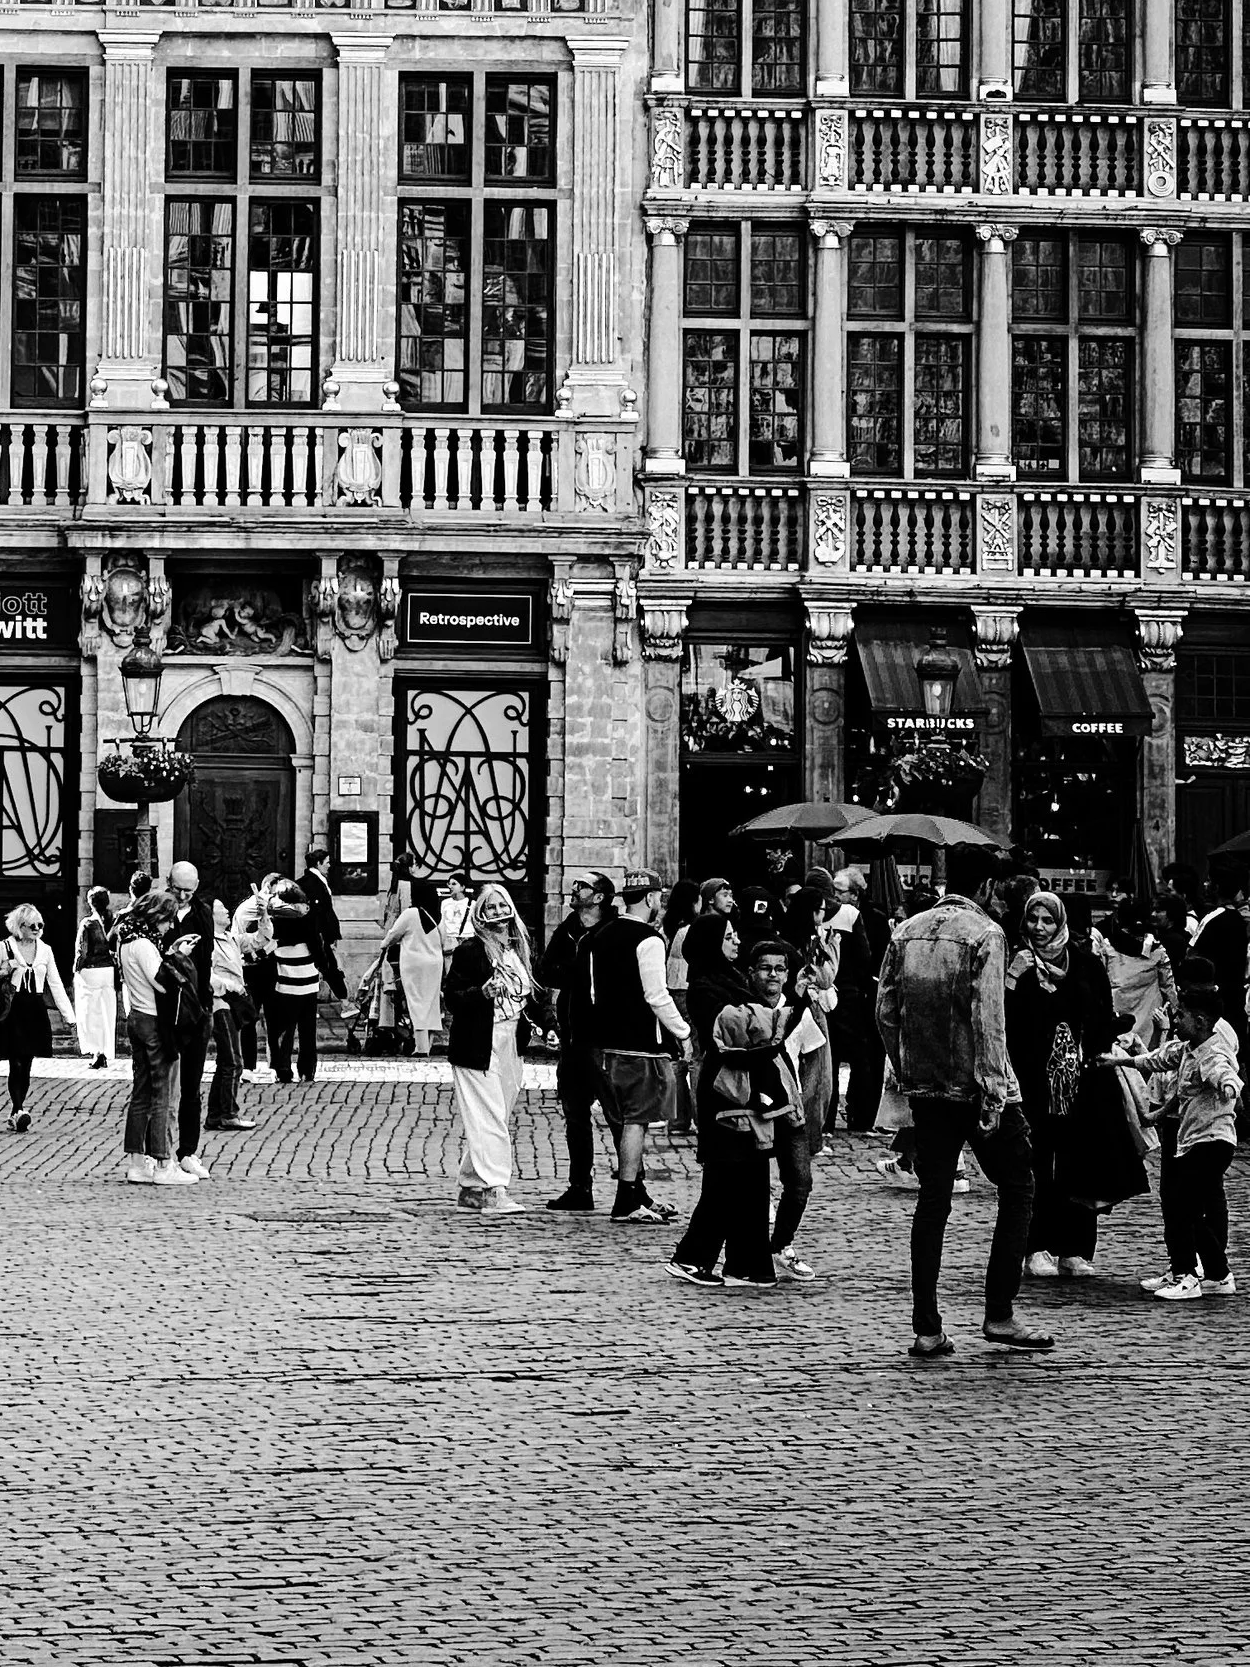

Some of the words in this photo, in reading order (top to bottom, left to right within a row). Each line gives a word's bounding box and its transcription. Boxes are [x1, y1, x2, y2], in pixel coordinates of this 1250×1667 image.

[419, 611, 520, 628] Retrospective
[887, 718, 975, 729] STARBUCKS
[1072, 722, 1123, 734] COFFEE
[1038, 878, 1098, 892] OFFEE
